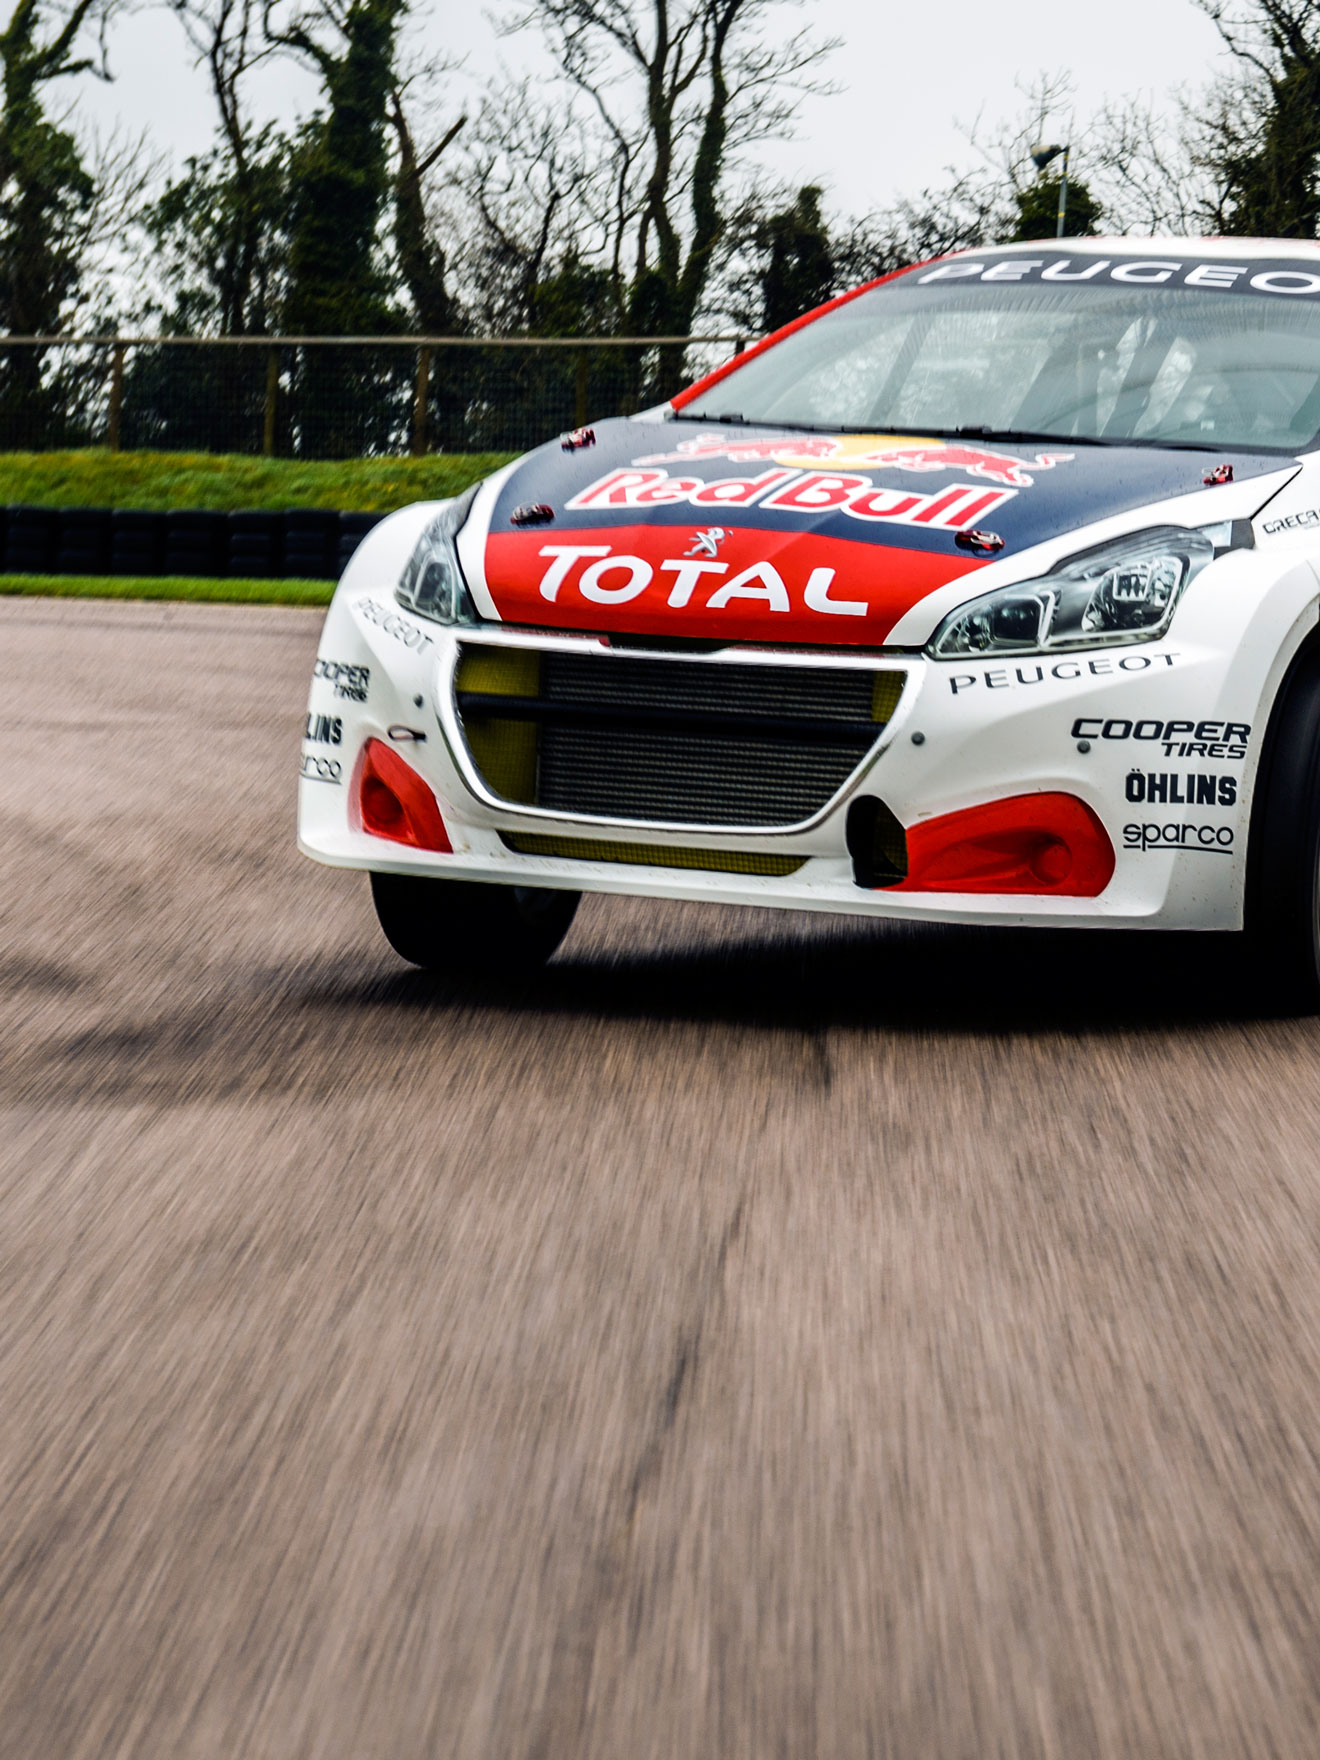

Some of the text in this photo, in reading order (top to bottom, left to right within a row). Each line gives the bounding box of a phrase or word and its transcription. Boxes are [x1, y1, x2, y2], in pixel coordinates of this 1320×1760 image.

[565, 467, 1019, 531] Red Bull
[538, 545, 869, 617] TOTAL
[949, 652, 1181, 695] PEUGEOT
[1071, 718, 1252, 744] COOPER
[1160, 741, 1248, 760] TIRES
[1125, 768, 1238, 807] ÖHLINS
[1122, 821, 1235, 852] sparco
